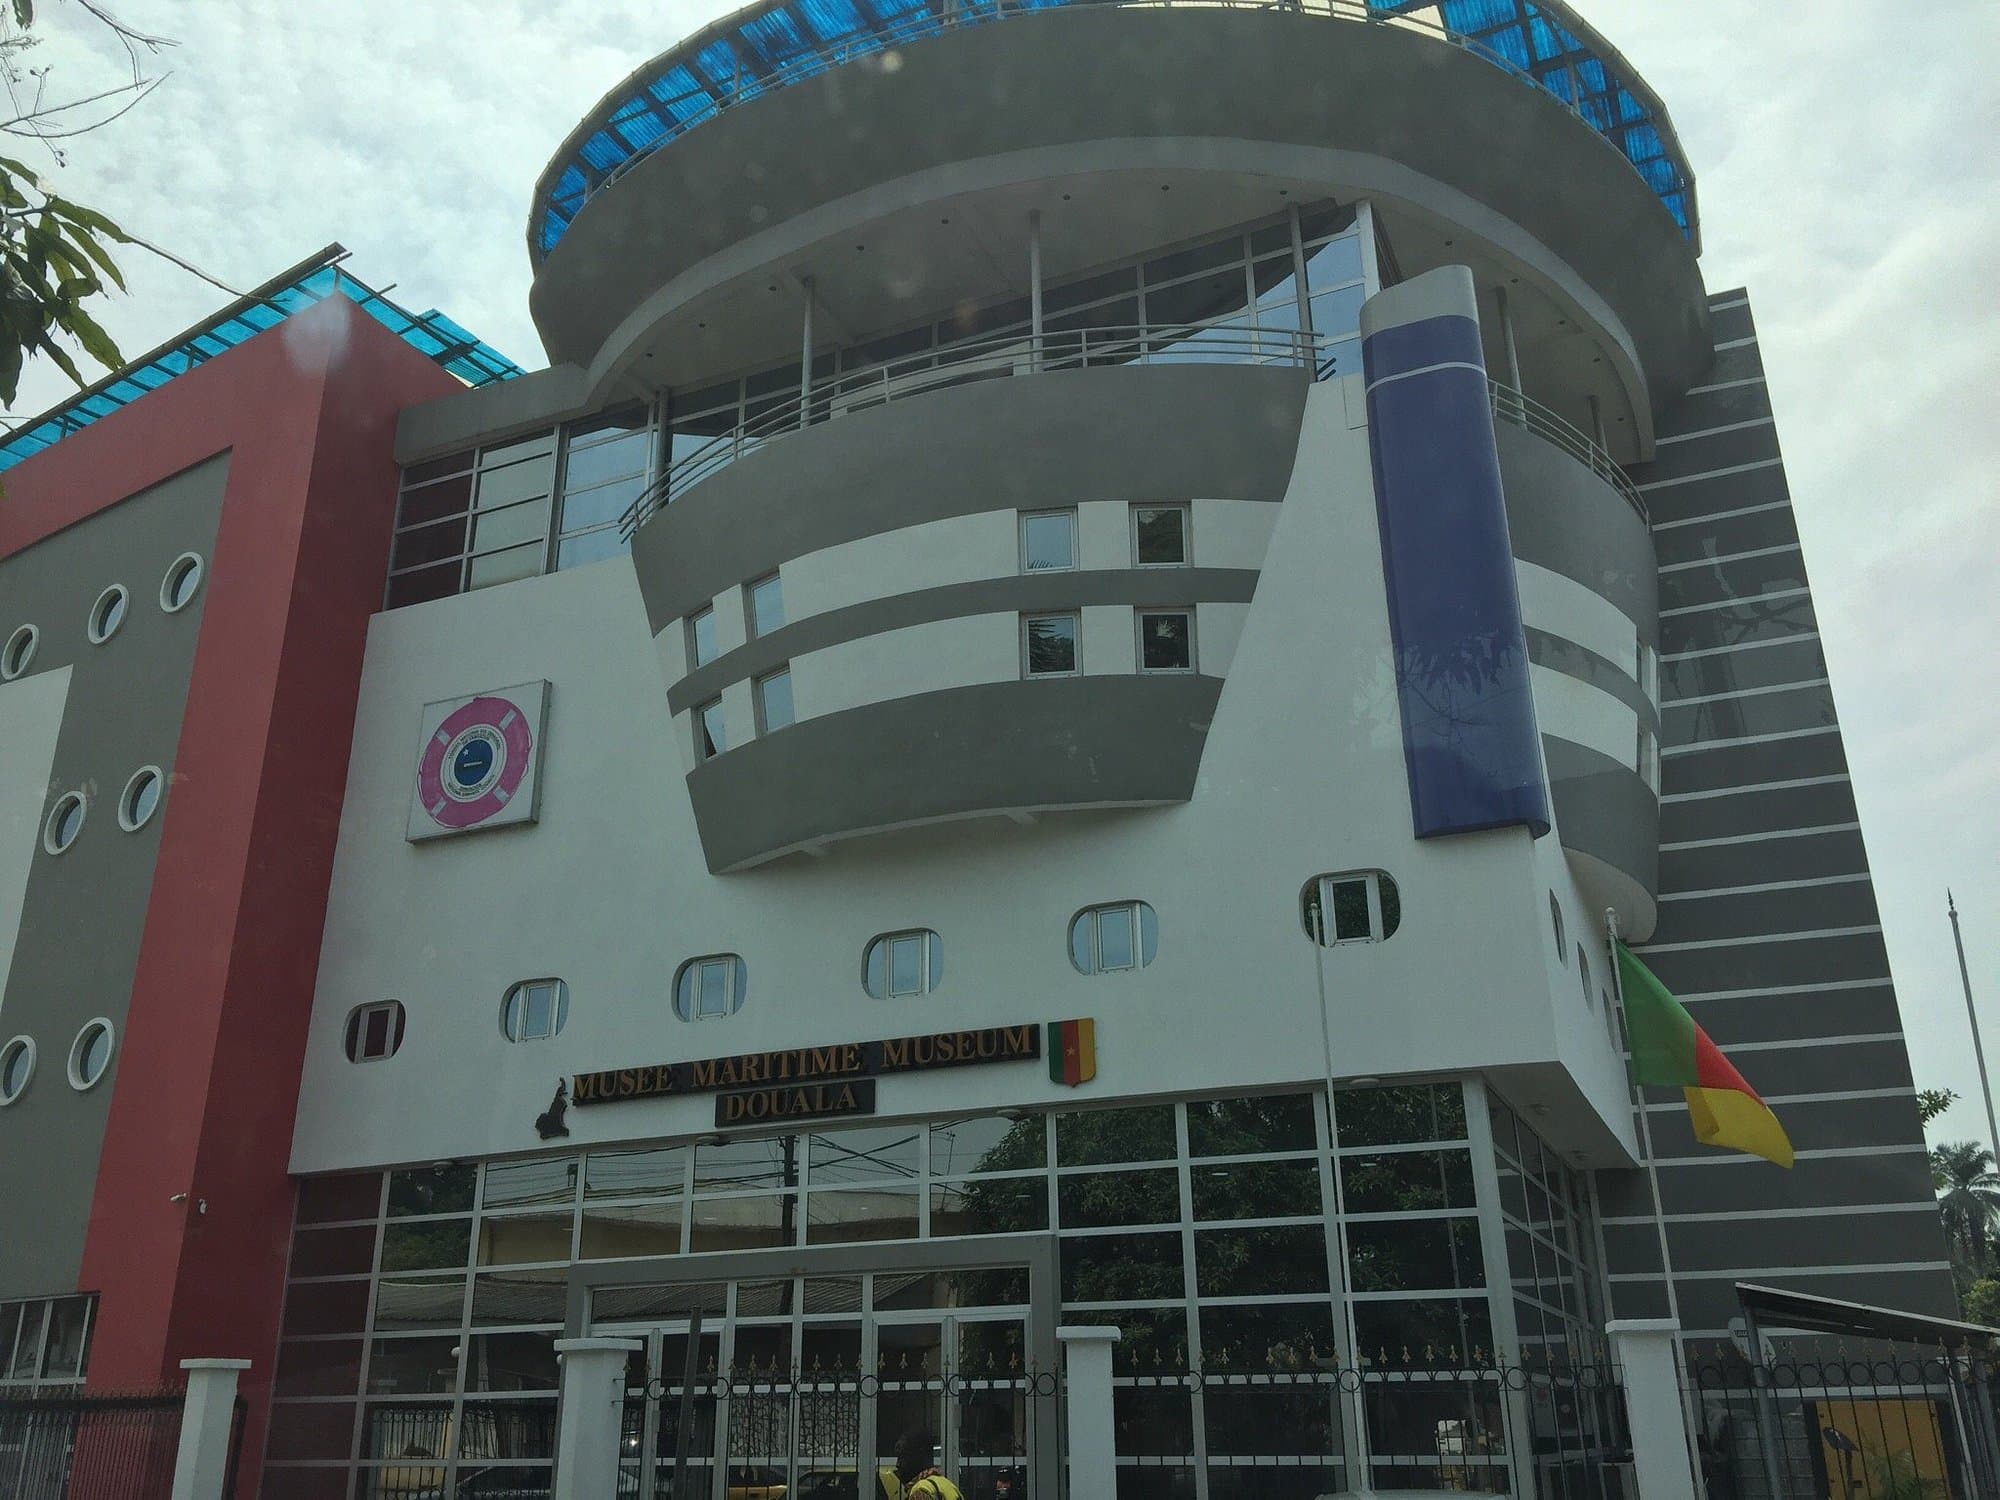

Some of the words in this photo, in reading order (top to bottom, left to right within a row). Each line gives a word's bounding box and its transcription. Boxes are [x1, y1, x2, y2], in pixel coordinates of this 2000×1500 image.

[691, 1043, 862, 1087] MARITIME
[880, 1024, 1032, 1068] MUSEUM
[726, 1083, 857, 1121] DOUALA
